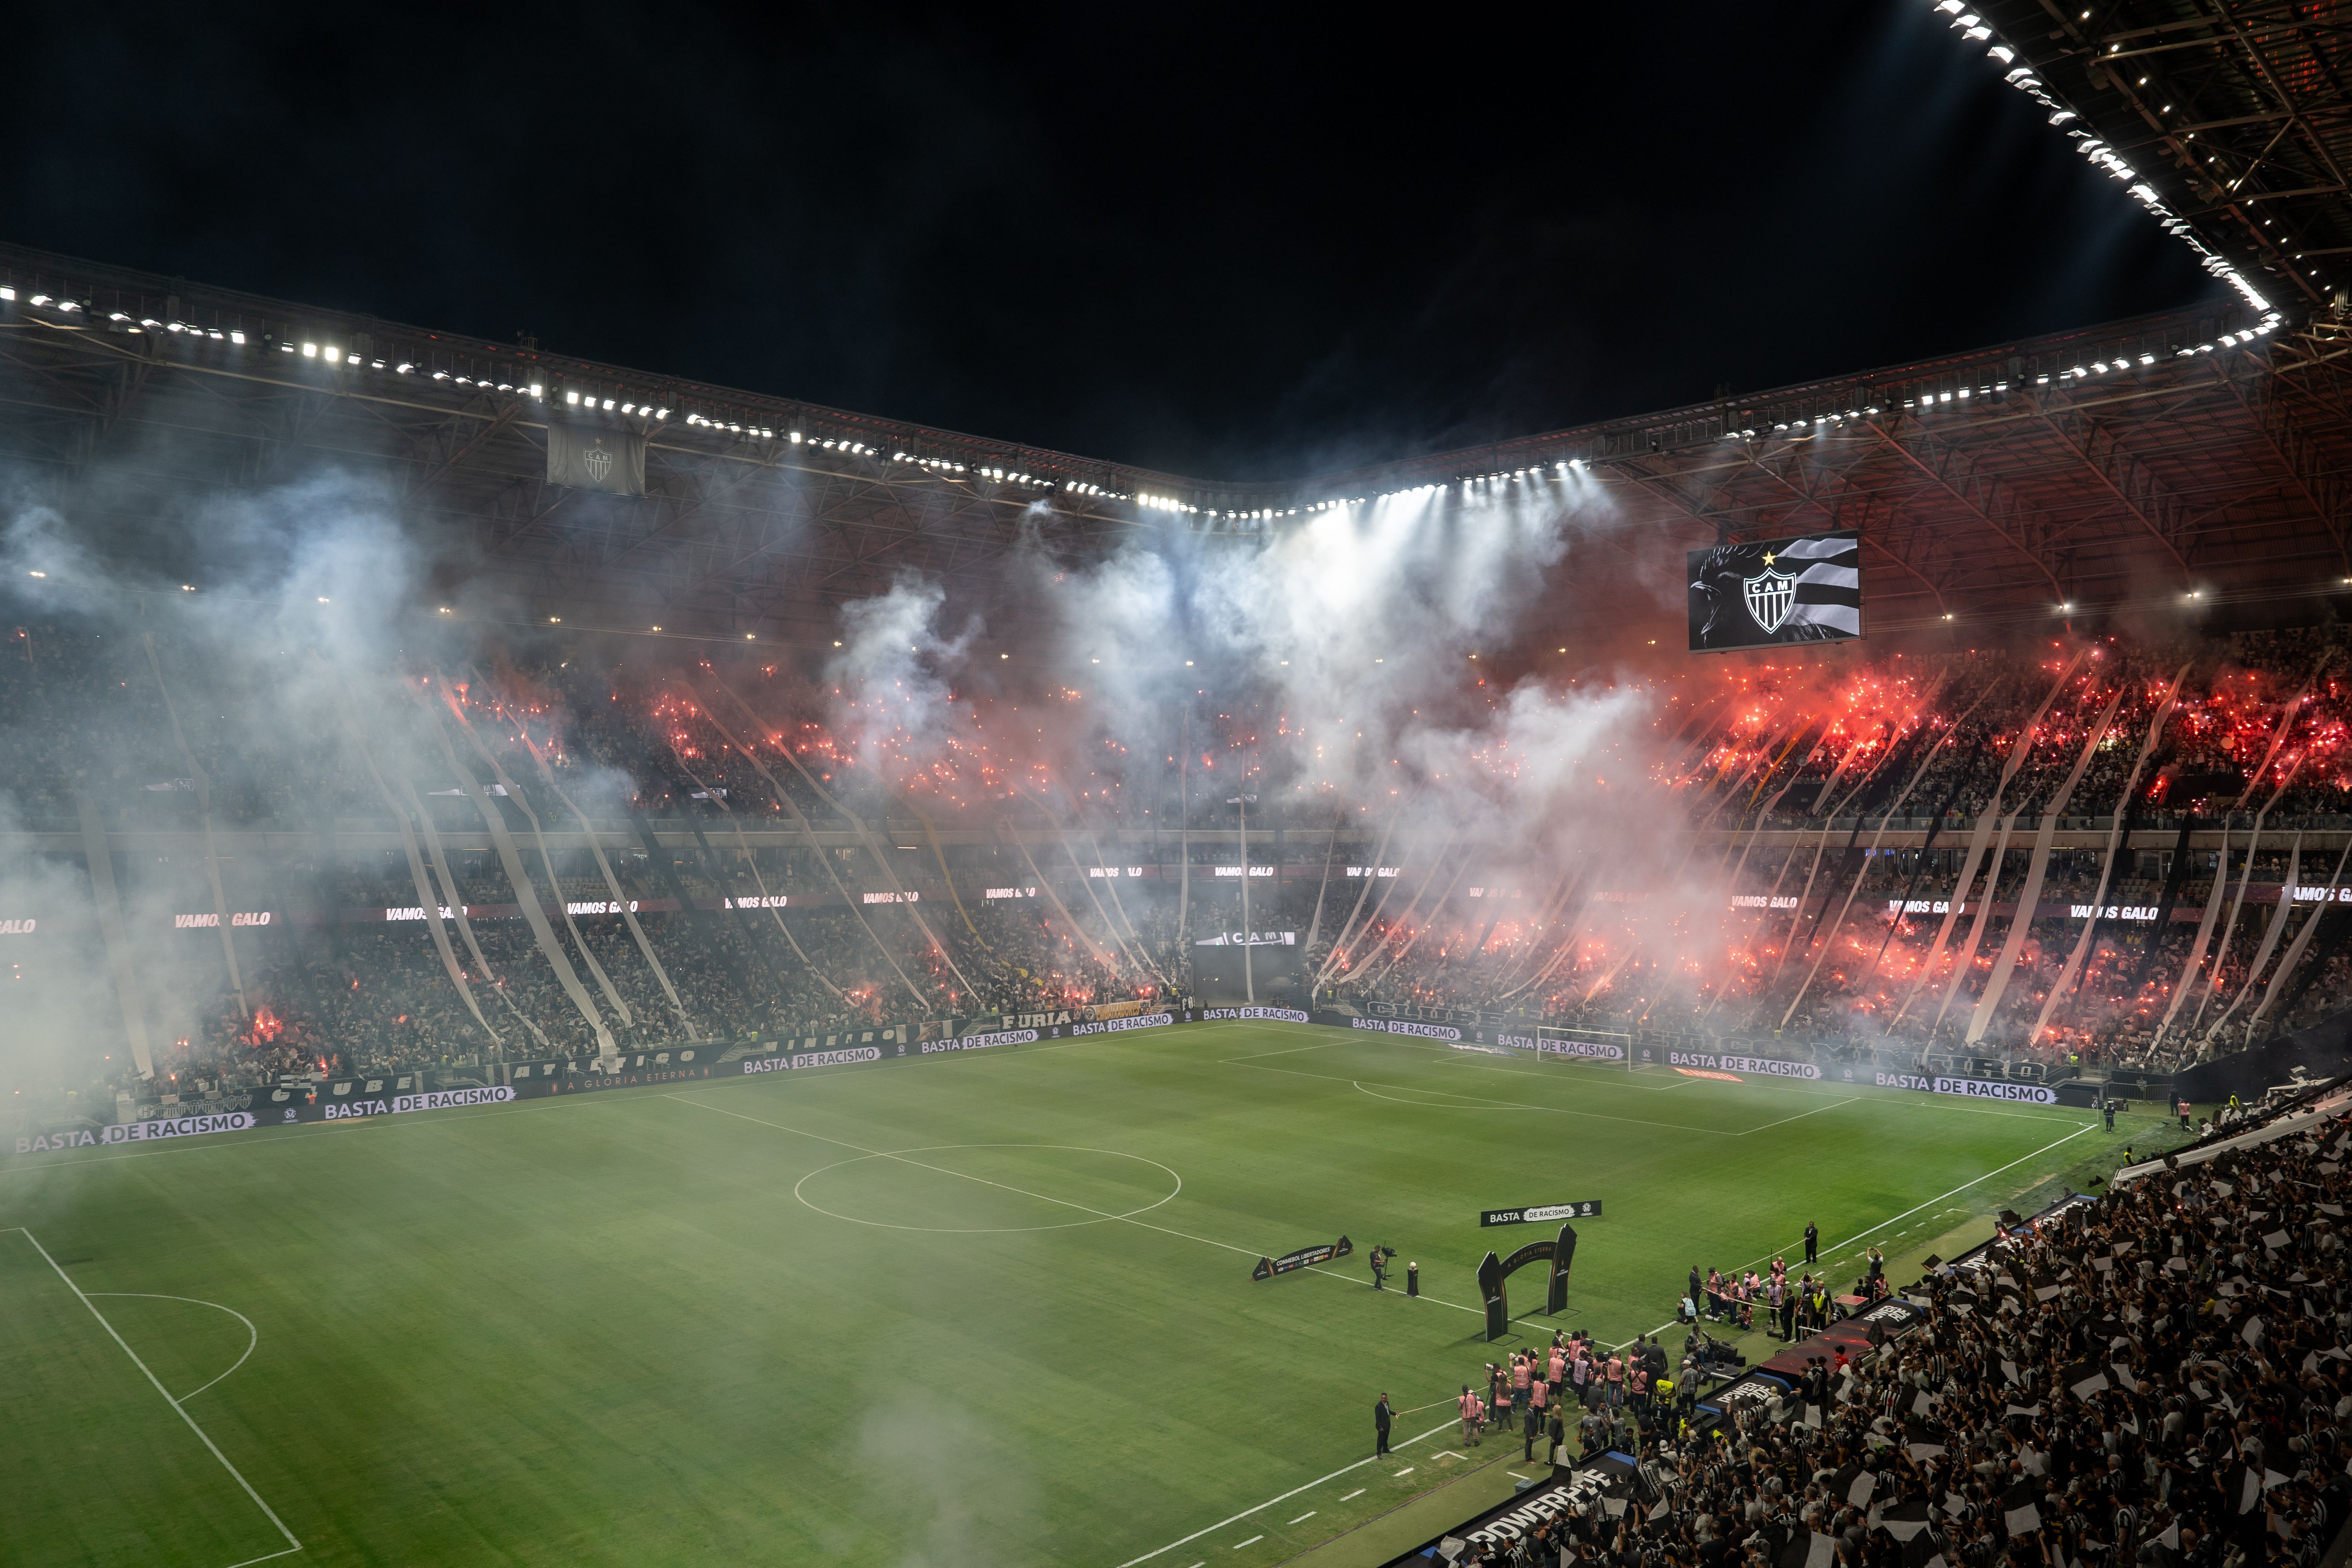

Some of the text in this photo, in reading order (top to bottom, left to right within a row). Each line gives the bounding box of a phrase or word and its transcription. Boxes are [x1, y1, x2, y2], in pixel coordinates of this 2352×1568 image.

[588, 453, 608, 461] CAM
[1752, 580, 1788, 593] CAM
[1215, 867, 1274, 877] VAMO GALO
[864, 893, 895, 904] VAMOS
[986, 888, 1014, 899] VAMOS
[2282, 886, 2336, 901] AMOS
[567, 902, 607, 915] VAMOS
[1731, 896, 1797, 908] VAMOS GALO
[175, 912, 270, 928] VAMO GALO
[2121, 907, 2159, 920] GALO
[0, 918, 36, 934] ALO
[1232, 932, 1277, 943] CAM
[1002, 1011, 1072, 1029] FURIA
[1204, 1008, 1304, 1022] BASTA DE RACISMO
[1073, 1014, 1169, 1036] BASTA DE RACISMO
[1352, 1018, 1456, 1039] BASTA DE RACISMO
[766, 1029, 895, 1052] MINEIRO
[922, 1031, 1033, 1053] BASTA DE RACISMO
[1498, 1034, 1534, 1049] BASTA
[1541, 1040, 1555, 1052] DE
[1560, 1042, 1617, 1058] RACISMO
[744, 1048, 875, 1074] BASTA DE RACISMO
[1670, 1052, 1815, 1078] BASTA DE RACISMO
[584, 1076, 637, 1088] GLÓRIA
[647, 1070, 695, 1081] ETERNA
[1876, 1073, 2048, 1102] BASTA DE RACISMO
[325, 1087, 508, 1119] BASTA DE RACISMO
[16, 1114, 245, 1154] BASTA DE RACISMO
[1490, 1212, 1520, 1223] BASTA
[1539, 1209, 1569, 1217] RACISMO
[1276, 1256, 1300, 1266] CONMEBOL
[1301, 1247, 1330, 1259] LIBERTADORES
[1863, 1305, 1899, 1321] POWER
[1887, 1308, 1911, 1322] ADE
[1716, 1382, 1762, 1403] POWER
